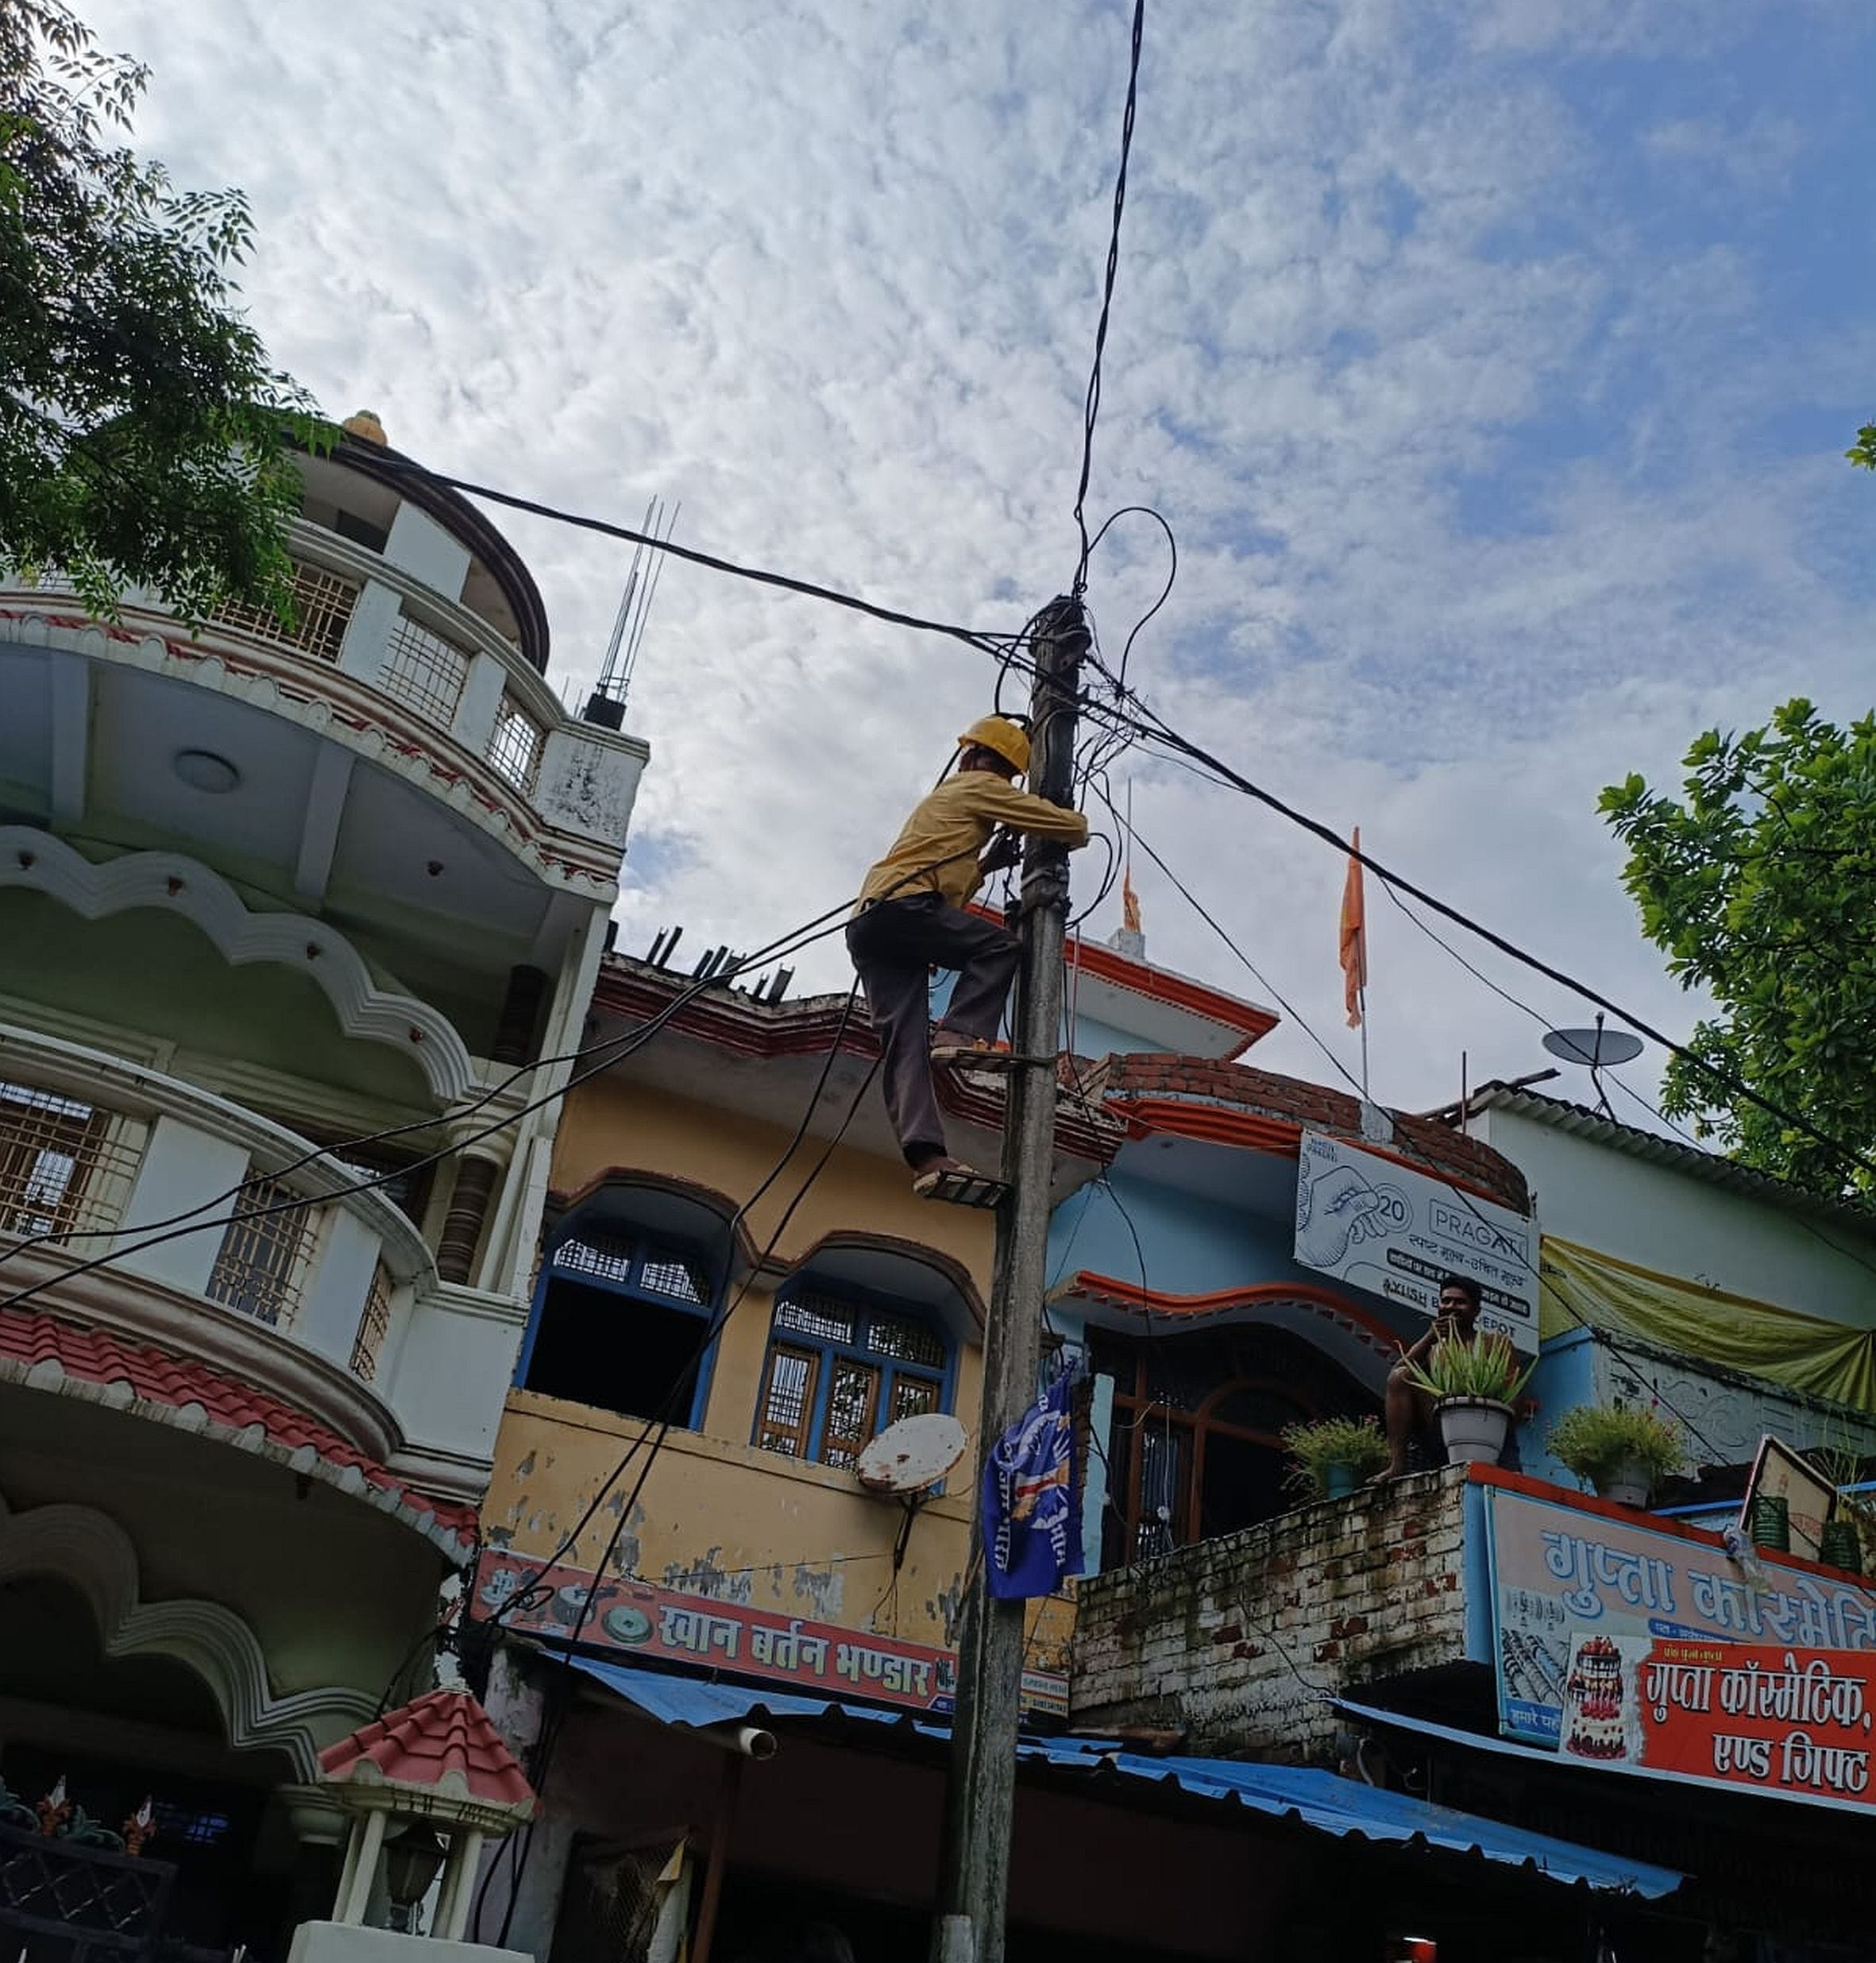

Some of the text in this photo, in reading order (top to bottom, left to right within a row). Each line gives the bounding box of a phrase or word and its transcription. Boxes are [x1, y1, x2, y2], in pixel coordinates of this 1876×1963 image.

[1380, 1195, 1404, 1221] 20
[1475, 1316, 1516, 1337] EPOT
[1538, 1529, 1676, 1619] गुप्ता
[658, 1605, 934, 1698] खान बर्तन भण्डार
[1646, 1662, 1716, 1723] गुप्ता
[1712, 1733, 1774, 1779] एण्ड
